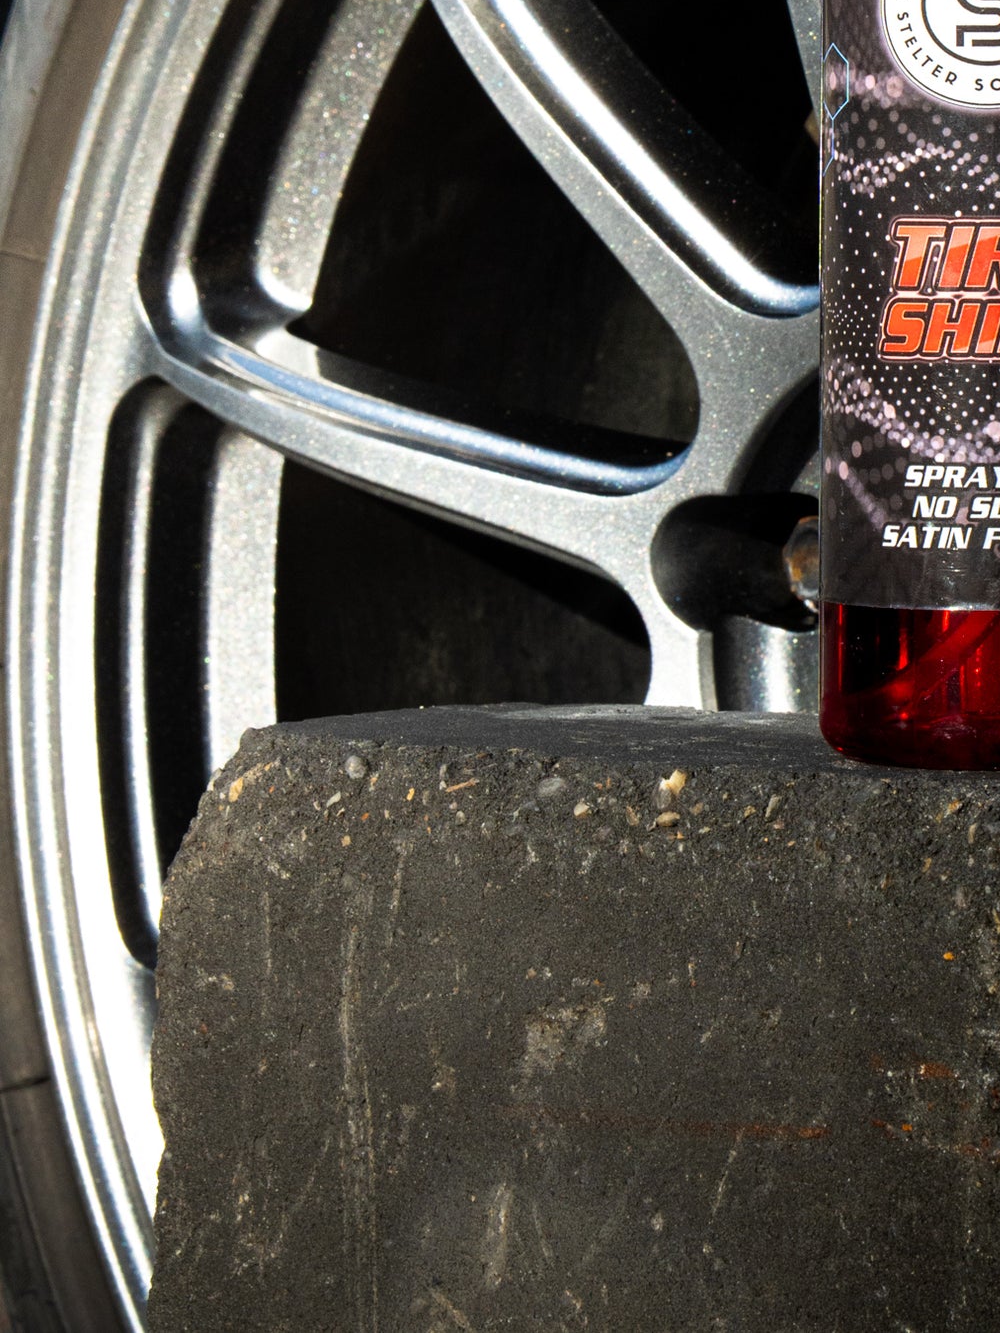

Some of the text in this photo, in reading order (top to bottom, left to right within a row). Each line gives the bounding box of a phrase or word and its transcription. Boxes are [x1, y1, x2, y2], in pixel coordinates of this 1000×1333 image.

[896, 11, 958, 86] STELTER
[911, 495, 959, 519] NO
[881, 524, 973, 550] SATIN
